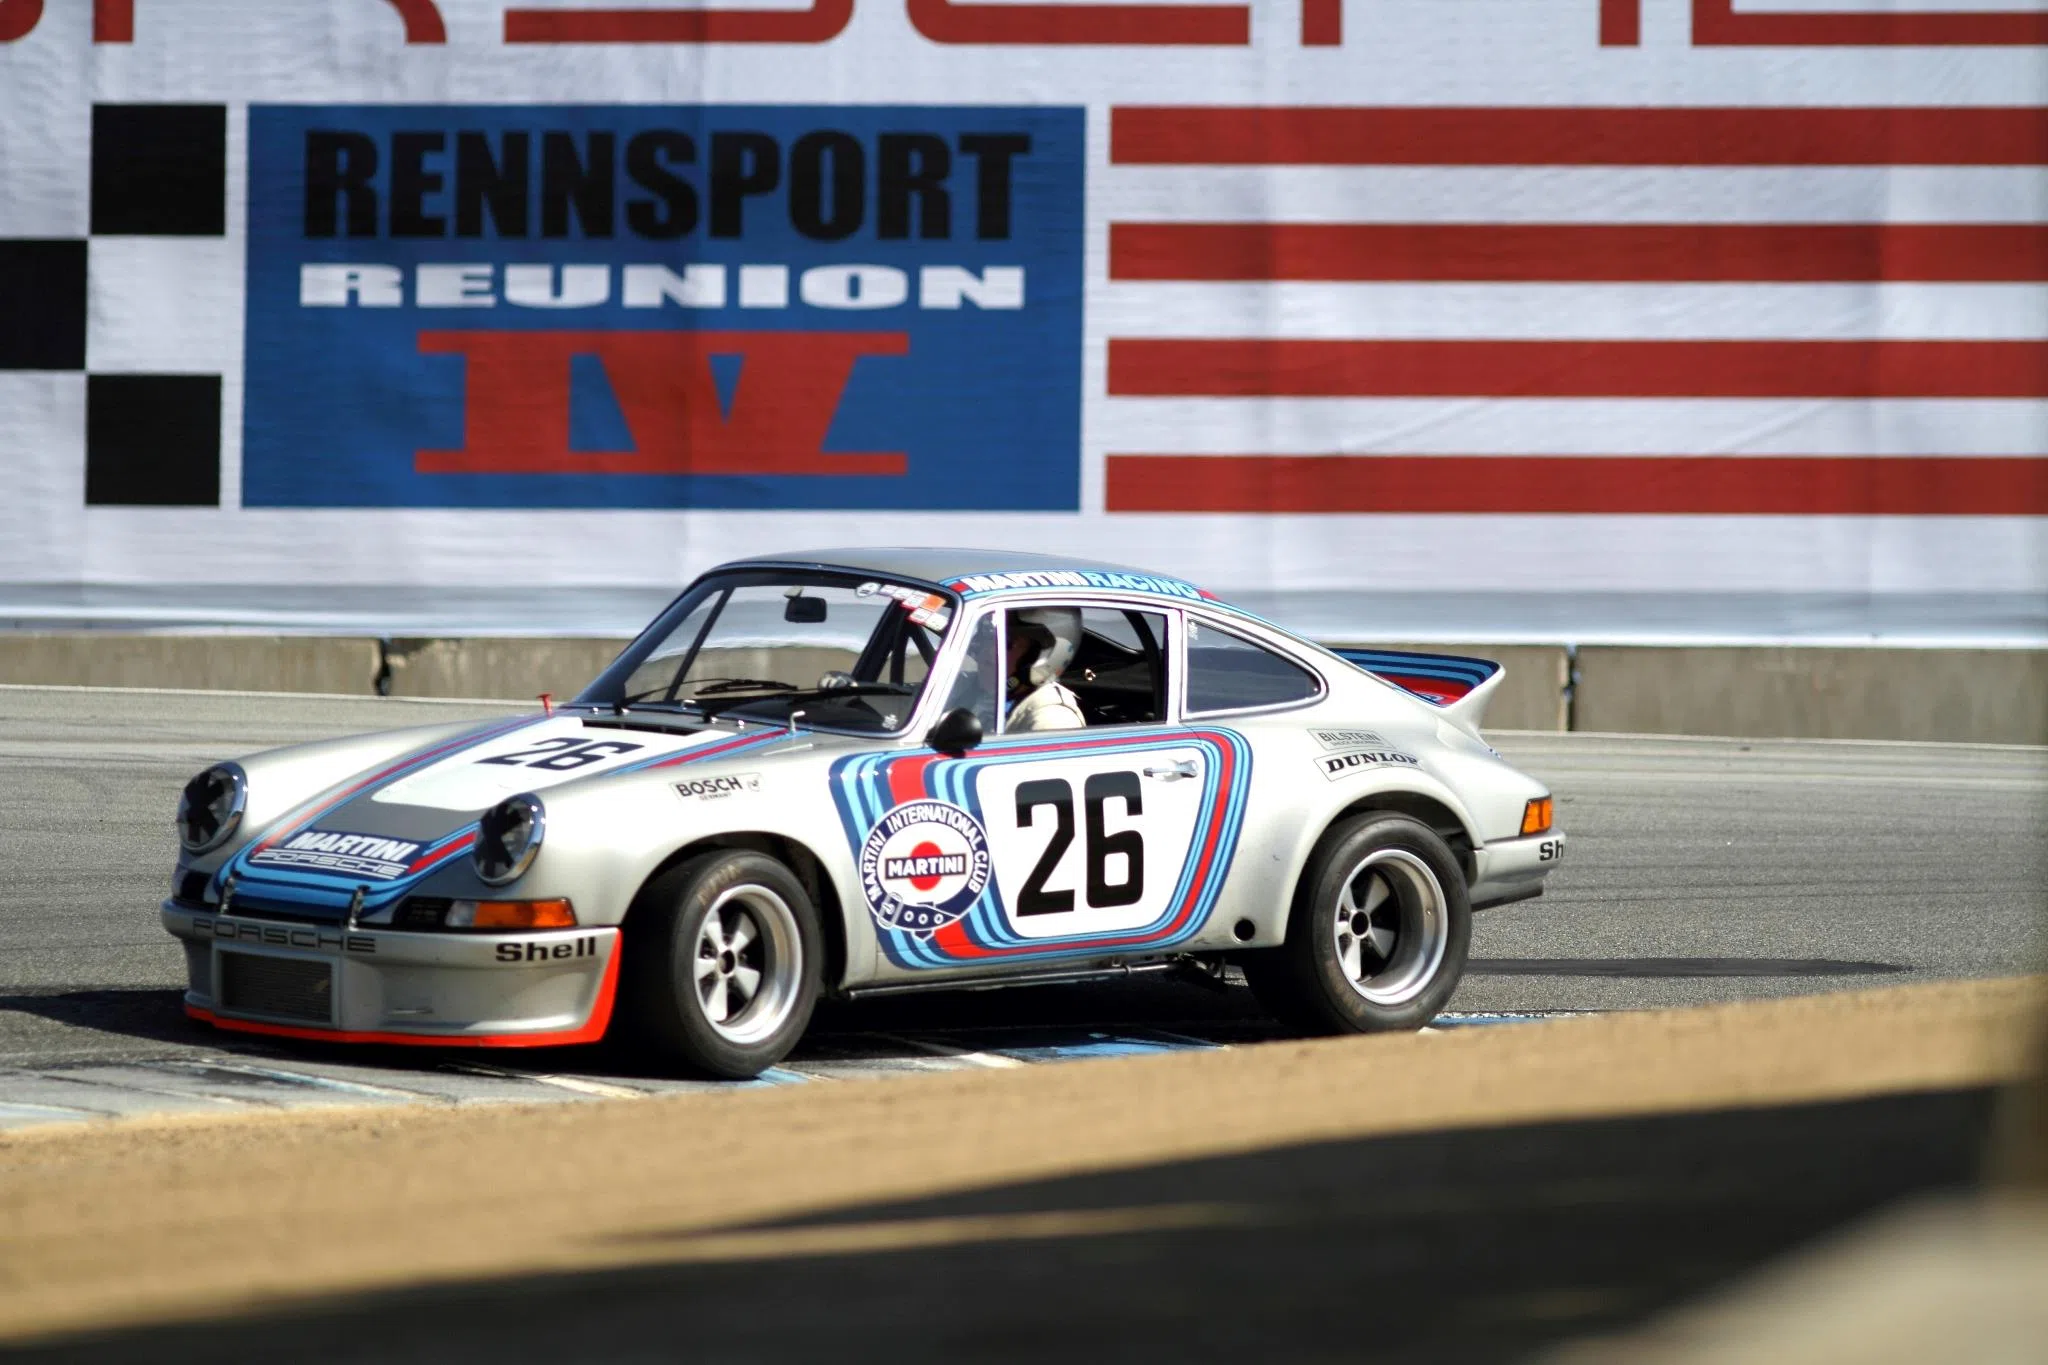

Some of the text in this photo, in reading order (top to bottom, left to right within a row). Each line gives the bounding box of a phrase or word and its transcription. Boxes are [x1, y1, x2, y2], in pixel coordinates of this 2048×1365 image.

[304, 129, 1030, 241] RENNSPORT
[300, 264, 1025, 309] REUNION
[413, 331, 909, 475] IV
[966, 571, 1200, 600] MARTINI RACING
[1318, 732, 1383, 742] BILSTEIN
[472, 737, 645, 771] 26
[1326, 752, 1418, 773] DUNLOP
[676, 777, 743, 797] BOSCH
[284, 832, 419, 862] MARTINI
[863, 804, 988, 902] MARTINI INTERNATIONAL CLUB
[1015, 770, 1144, 917] 26
[254, 851, 405, 877] PORSCHE
[888, 856, 964, 877] MARTINI
[193, 917, 376, 952] PORSCHE
[495, 936, 596, 962] Shell
